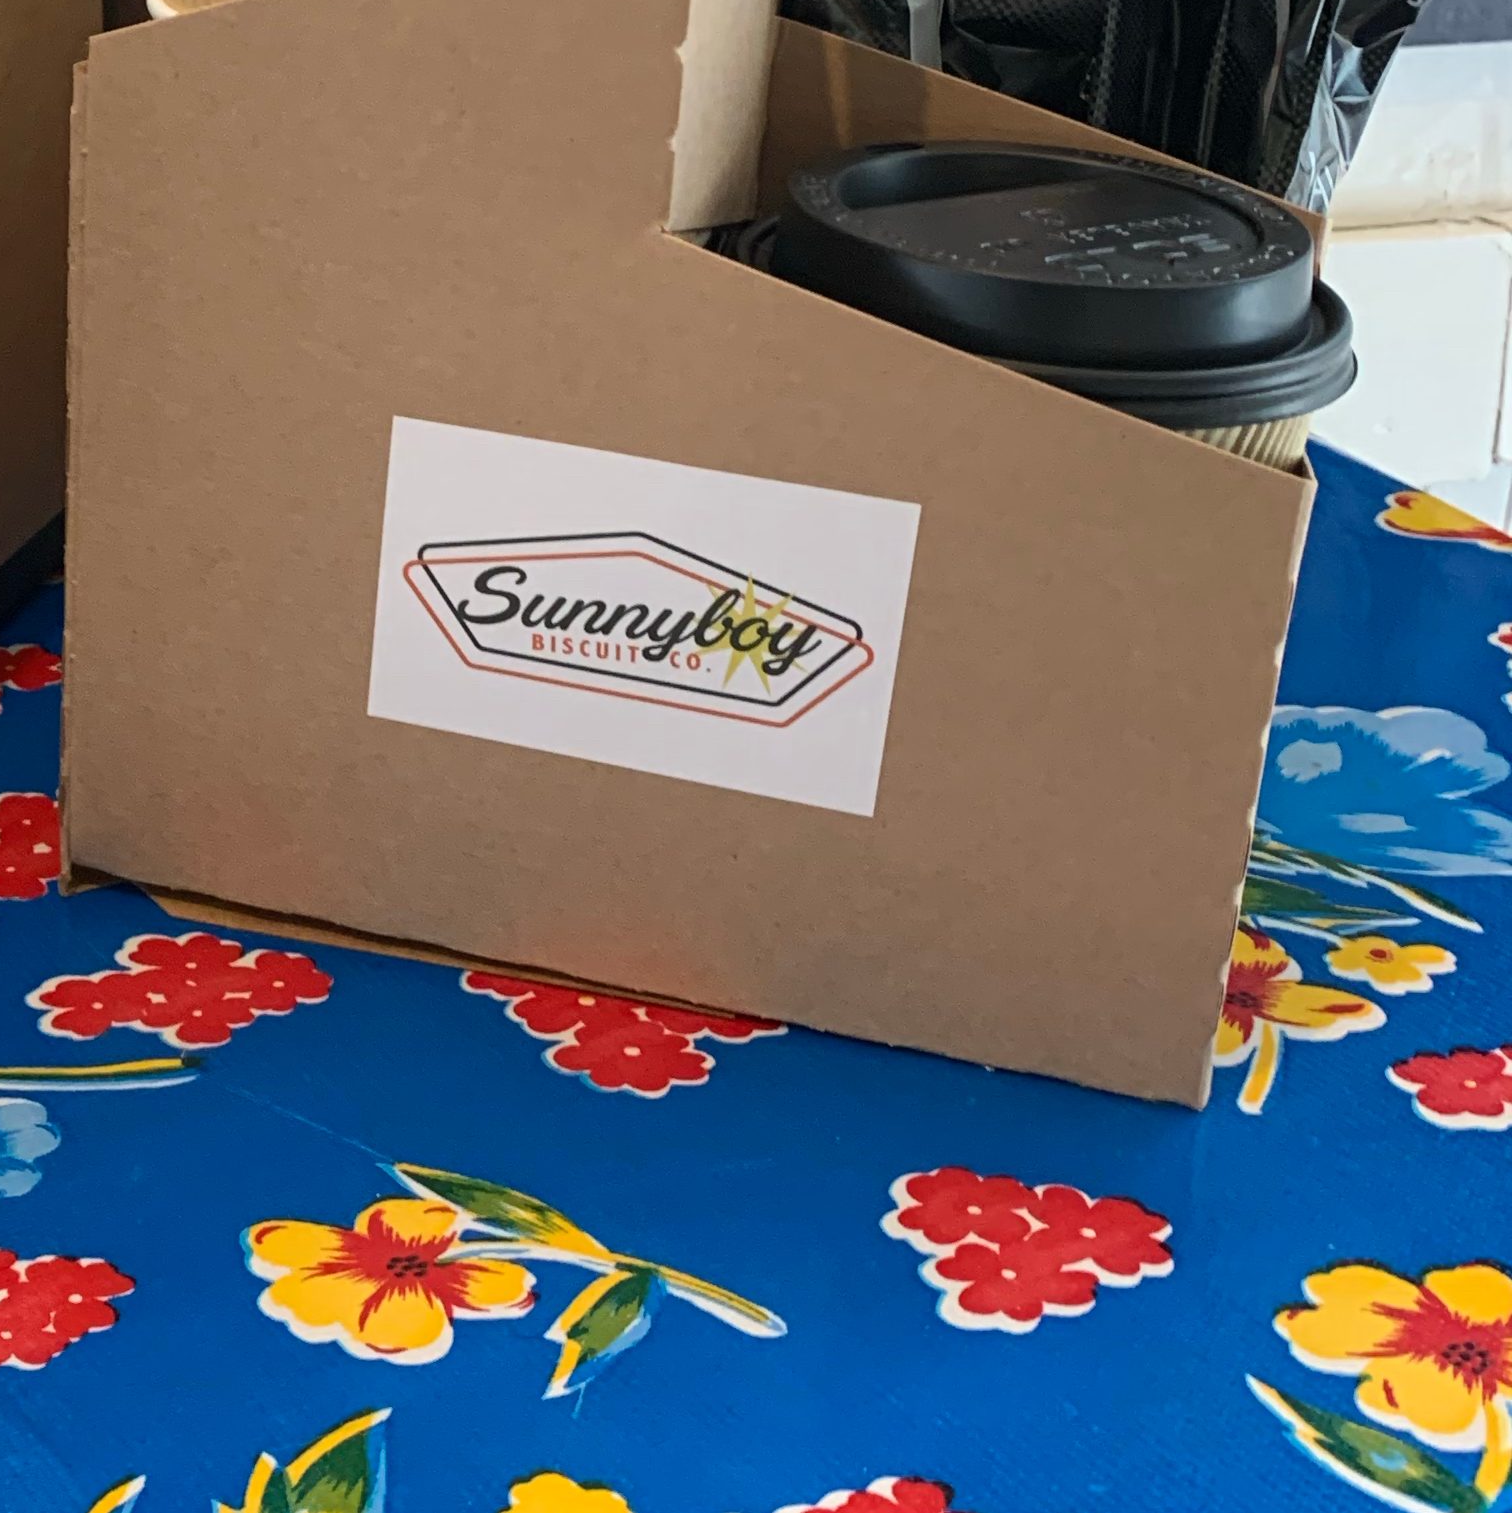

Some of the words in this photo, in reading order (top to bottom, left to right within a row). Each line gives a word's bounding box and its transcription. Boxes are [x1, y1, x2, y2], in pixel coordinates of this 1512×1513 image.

[456, 565, 823, 676] Sunnyboy
[531, 633, 640, 665] BISCUIT
[669, 650, 712, 674] CO.
